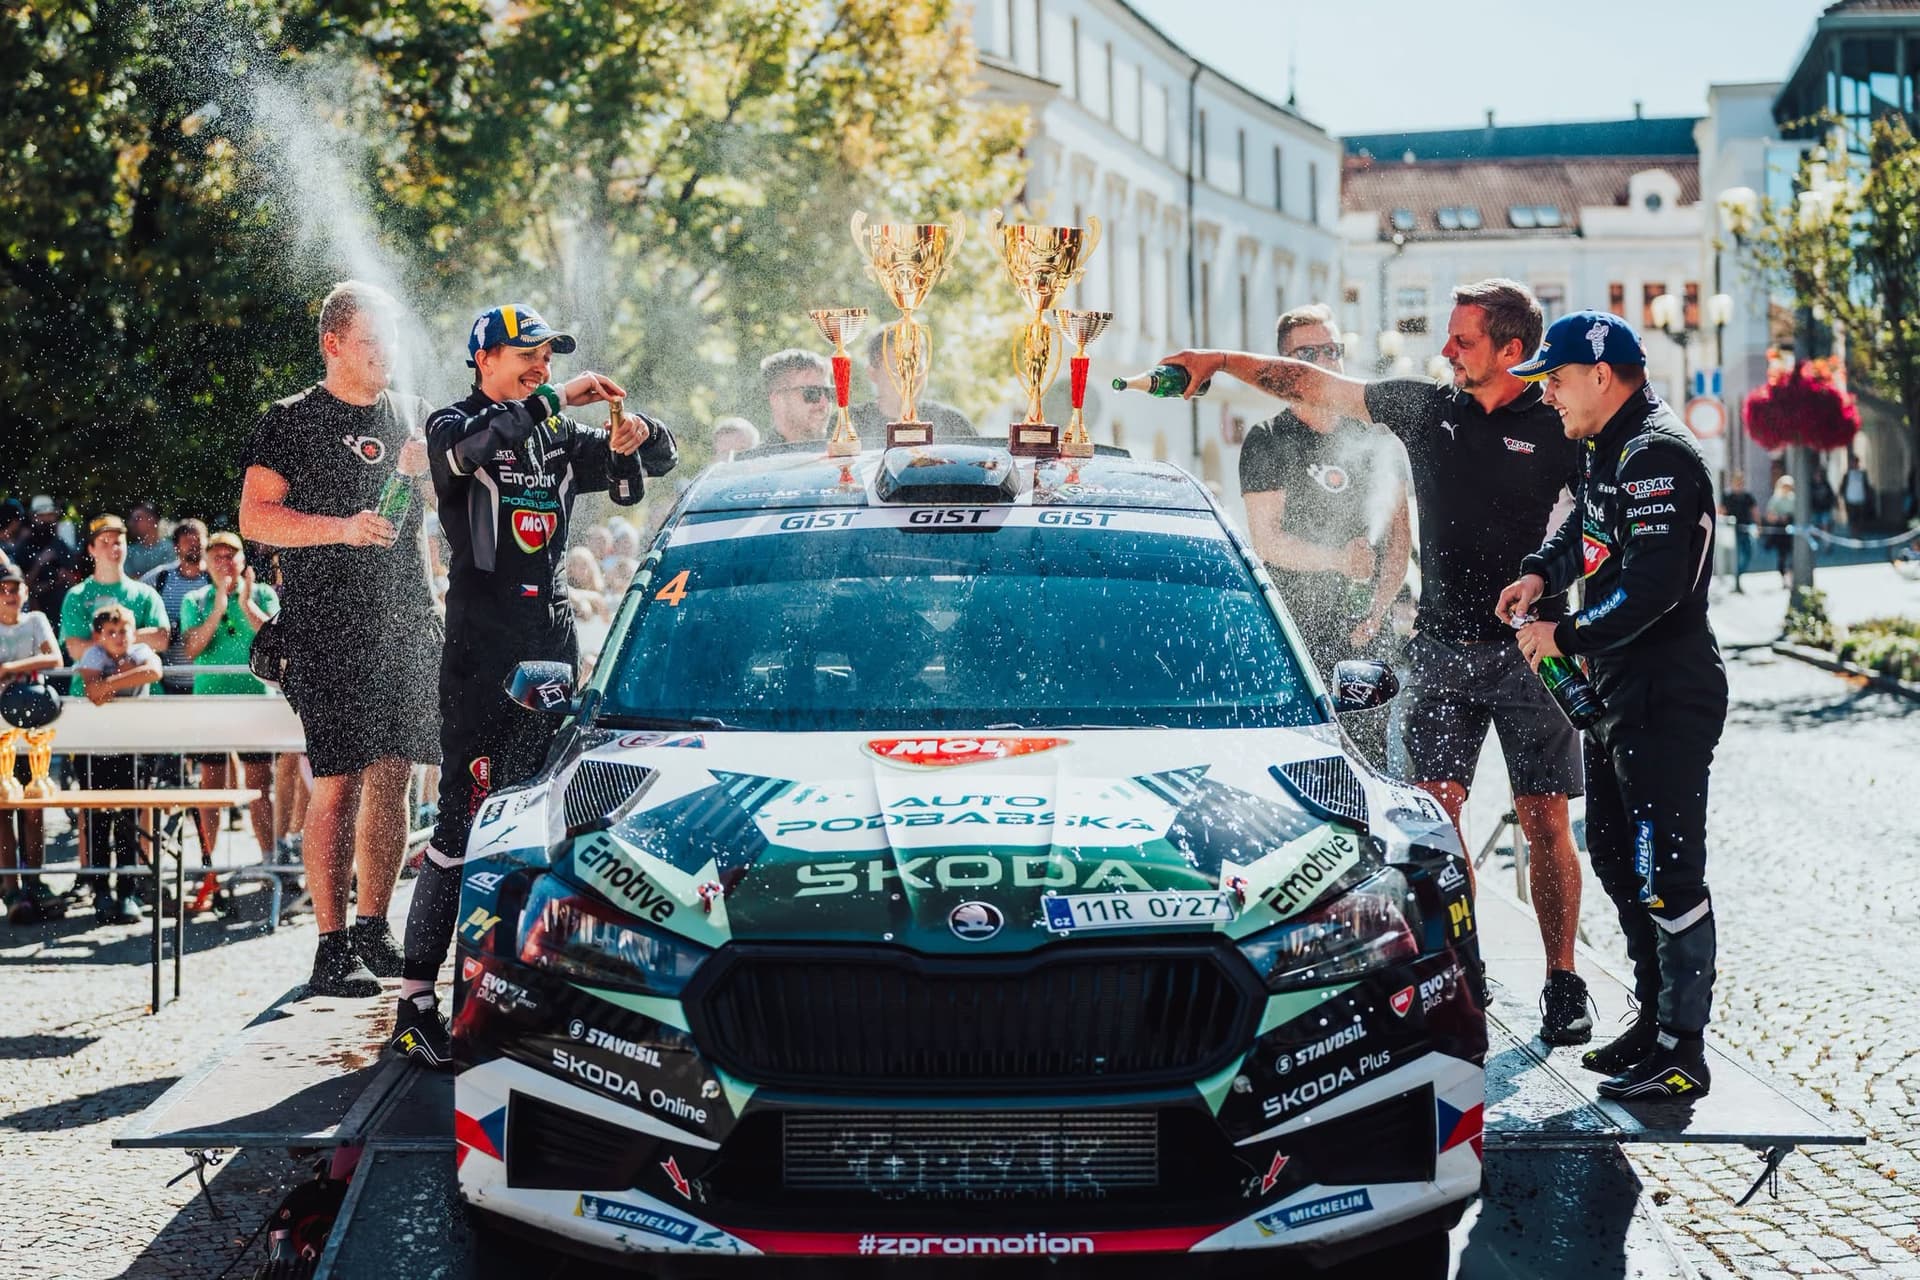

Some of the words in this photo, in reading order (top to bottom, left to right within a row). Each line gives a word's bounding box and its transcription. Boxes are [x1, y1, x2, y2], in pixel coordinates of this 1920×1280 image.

[1626, 477, 1675, 495] ORSAK
[655, 570, 690, 607] 4
[889, 740, 1004, 756] MOL
[480, 761, 488, 780] MOL
[889, 795, 1047, 808] AUTO
[1639, 825, 1650, 894] CHELIN
[578, 836, 676, 923] Emotive
[1260, 834, 1354, 915] Emotive
[1054, 917, 1071, 927] CZ
[1076, 900, 1133, 922] 11R
[1148, 897, 1220, 918] 0727
[476, 987, 498, 1004] plus
[481, 972, 508, 995] EVO
[1419, 974, 1444, 1000] EVO
[1423, 992, 1443, 1015] plus
[586, 1028, 662, 1068] STAVOSIL
[1295, 1023, 1368, 1067] STAVOSIL
[1359, 1050, 1391, 1076] Plus
[650, 1089, 708, 1124] Online
[602, 1204, 688, 1238] MICHELIN
[1288, 1193, 1365, 1223] MICHELIN
[858, 1232, 1094, 1255] #zpromotion
